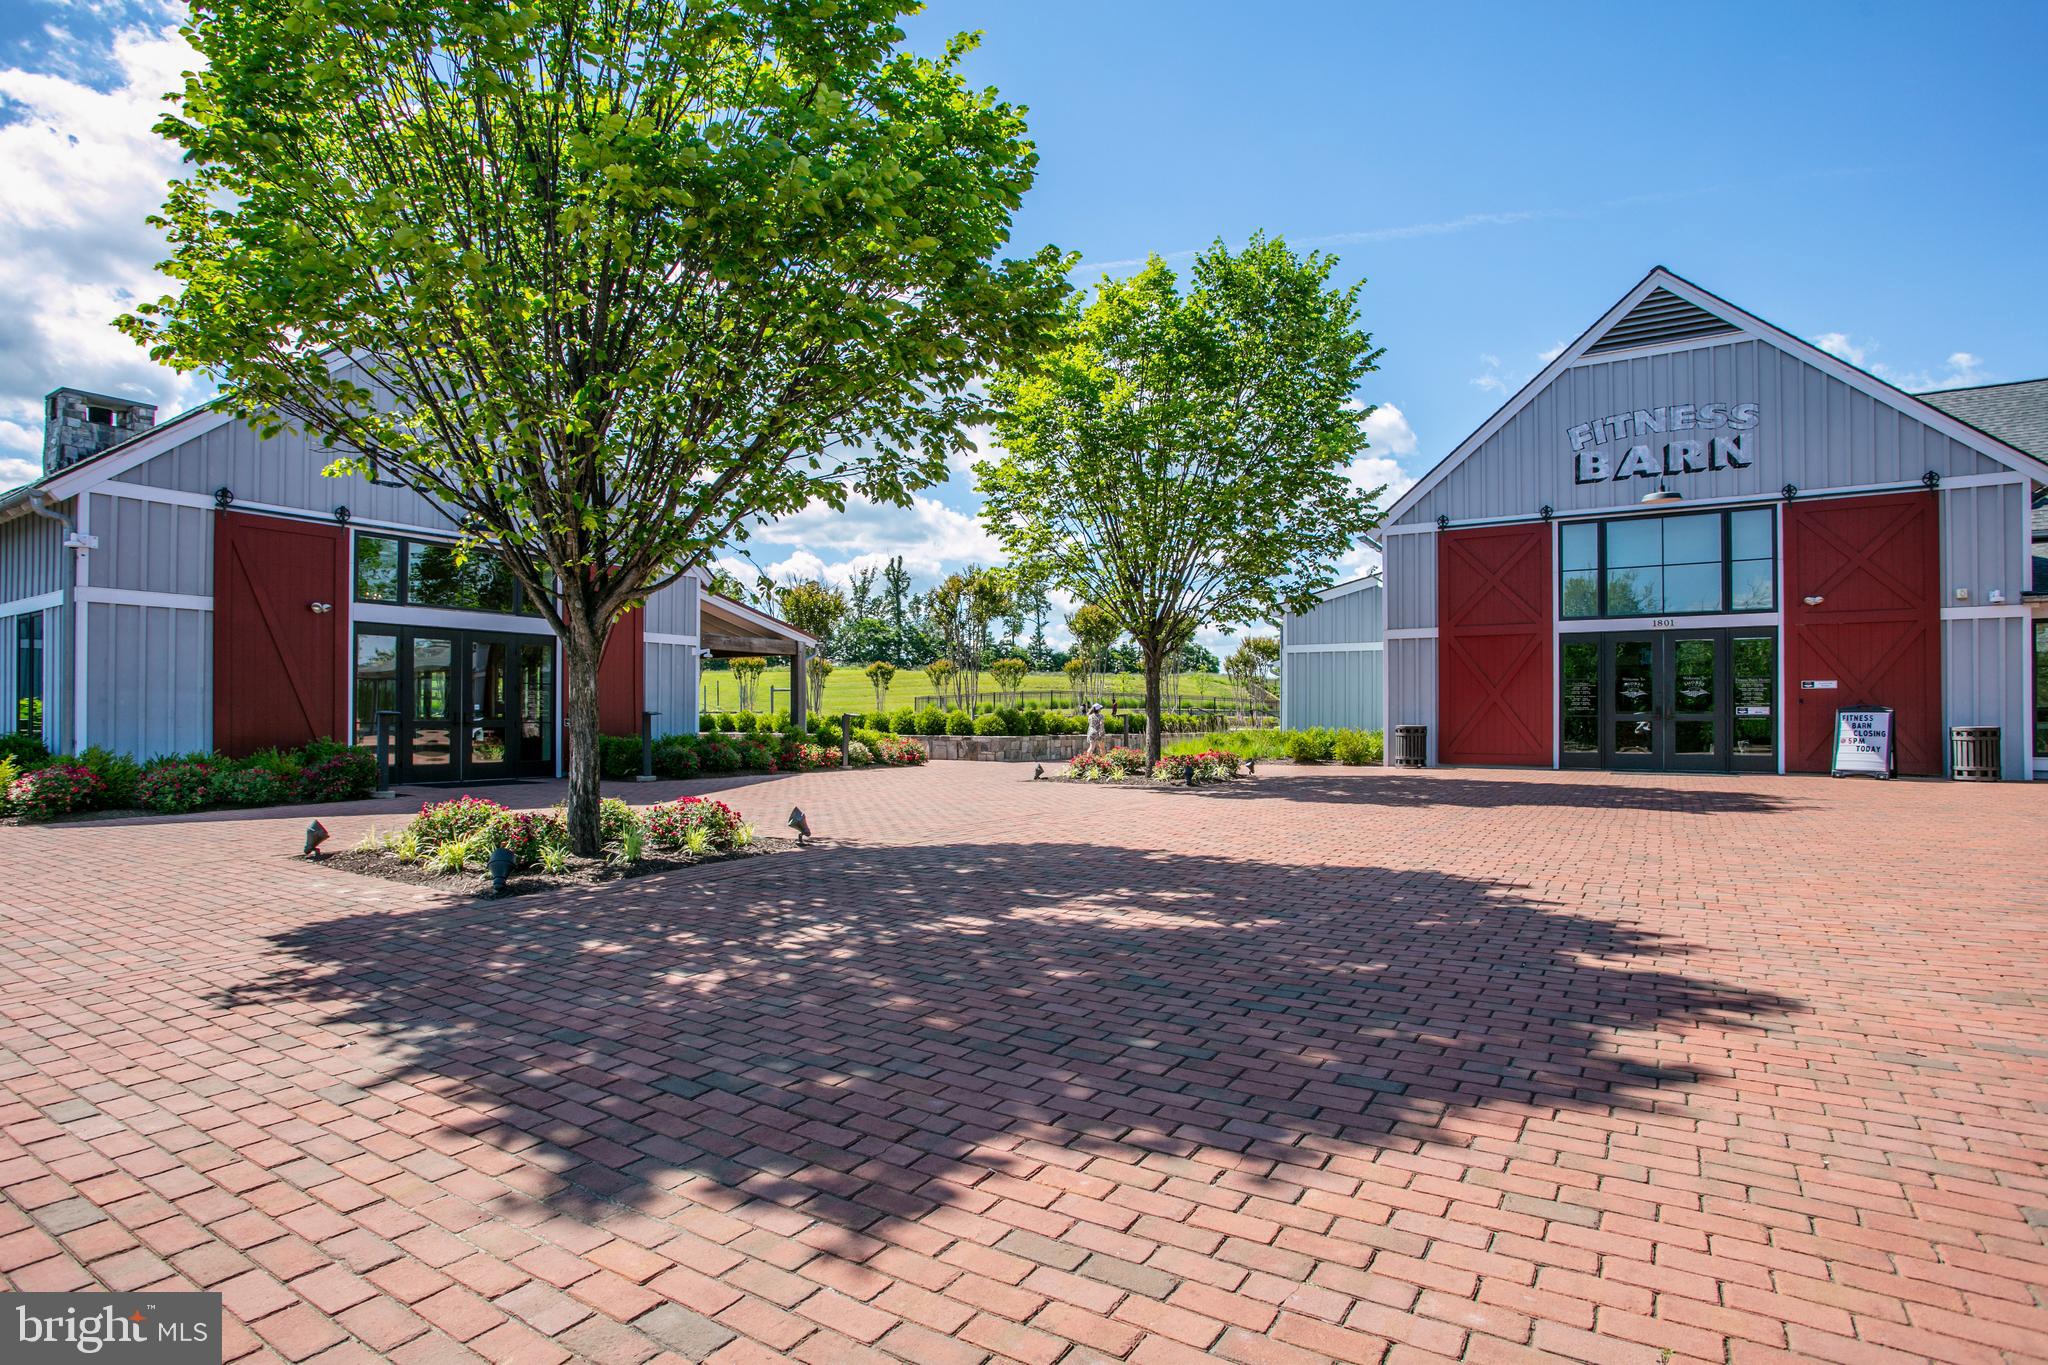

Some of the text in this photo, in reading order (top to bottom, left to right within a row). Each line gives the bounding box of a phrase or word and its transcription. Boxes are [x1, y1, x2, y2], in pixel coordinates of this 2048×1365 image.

[1567, 403, 1760, 451] FITNESS
[1575, 433, 1753, 485] BARN
[1653, 619, 1675, 627] 1801
